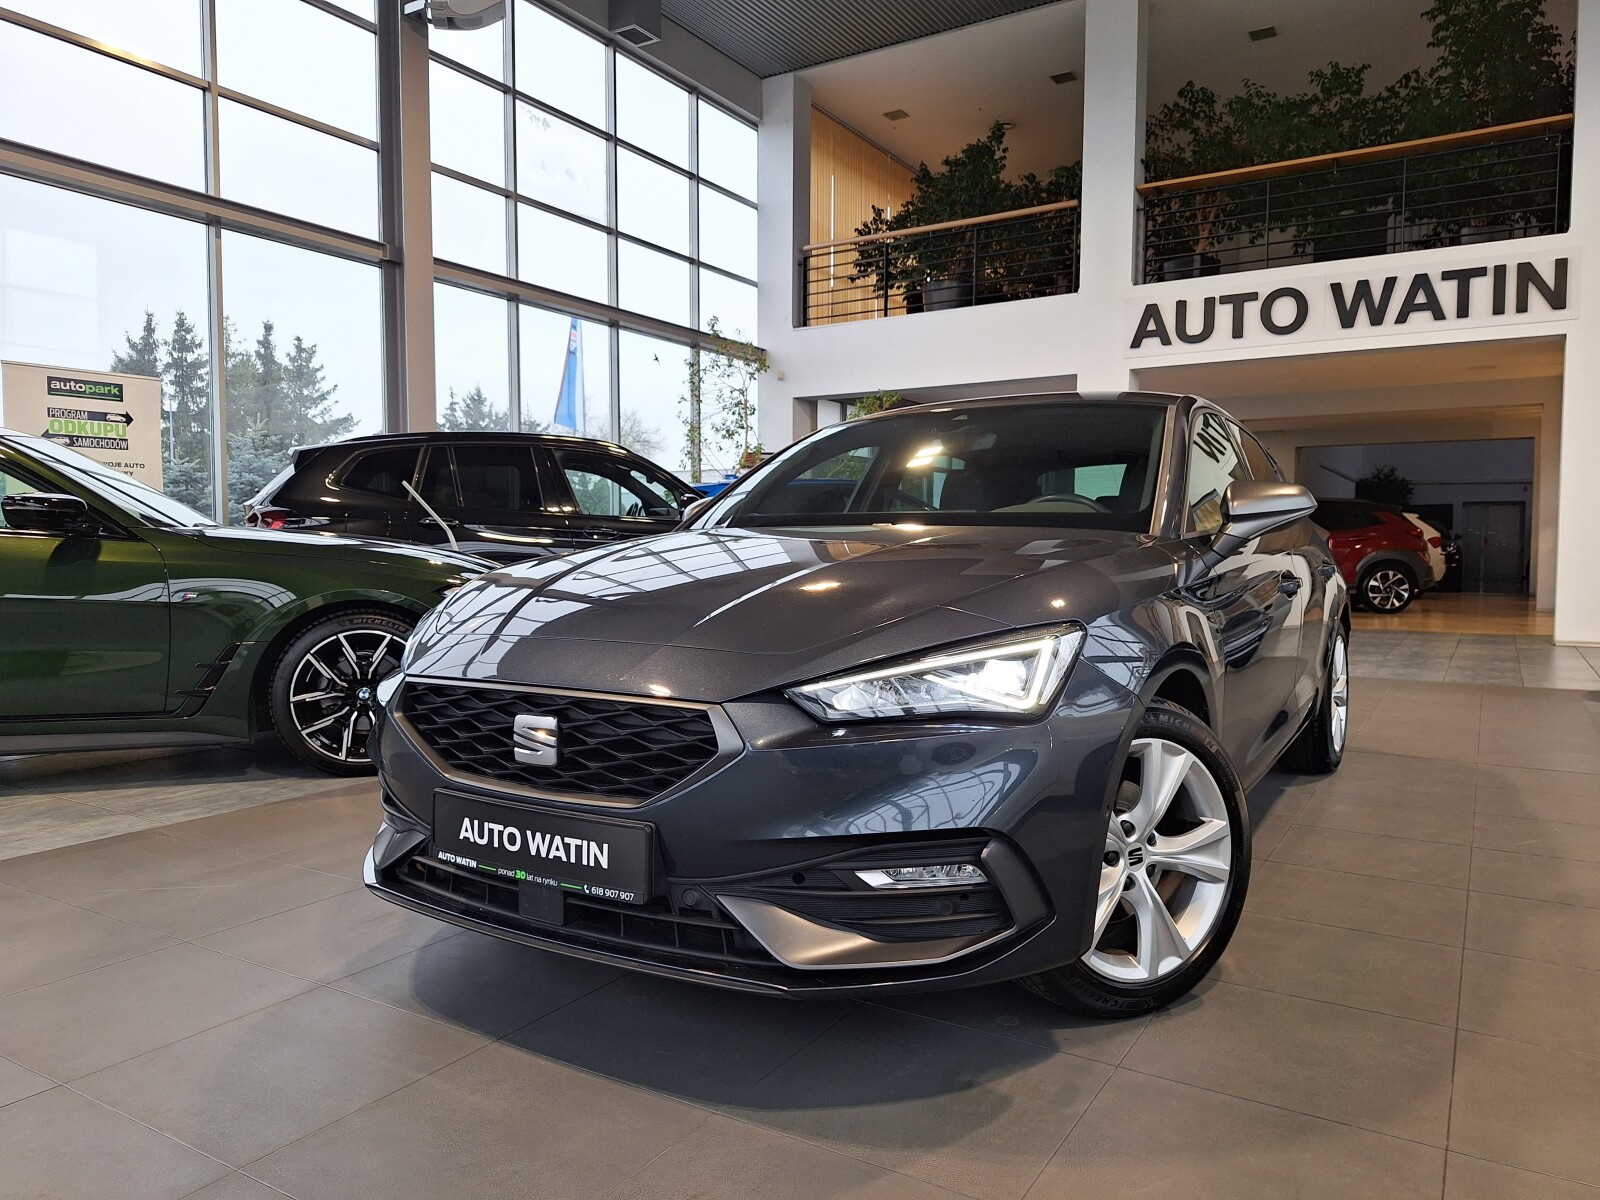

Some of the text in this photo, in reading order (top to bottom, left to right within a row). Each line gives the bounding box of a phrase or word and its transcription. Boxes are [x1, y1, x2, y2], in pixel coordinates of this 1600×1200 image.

[1130, 257, 1569, 349] AUTO WATIN
[50, 380, 120, 395] autopark
[49, 408, 88, 420] PROGRAM
[49, 419, 127, 438] ODKUPU
[73, 438, 128, 450] SAMOCHODÓW
[353, 618, 406, 632] MICHELIN
[1158, 713, 1215, 749] MICHEIN
[459, 817, 609, 870] AUTO WATIN
[438, 851, 456, 862] AUTO
[456, 855, 477, 868] WATIN
[497, 868, 515, 877] ponad
[515, 870, 526, 879] 30
[543, 878, 558, 886] rynku
[591, 886, 604, 896] 618
[605, 888, 619, 899] 907
[619, 891, 635, 901] 907
